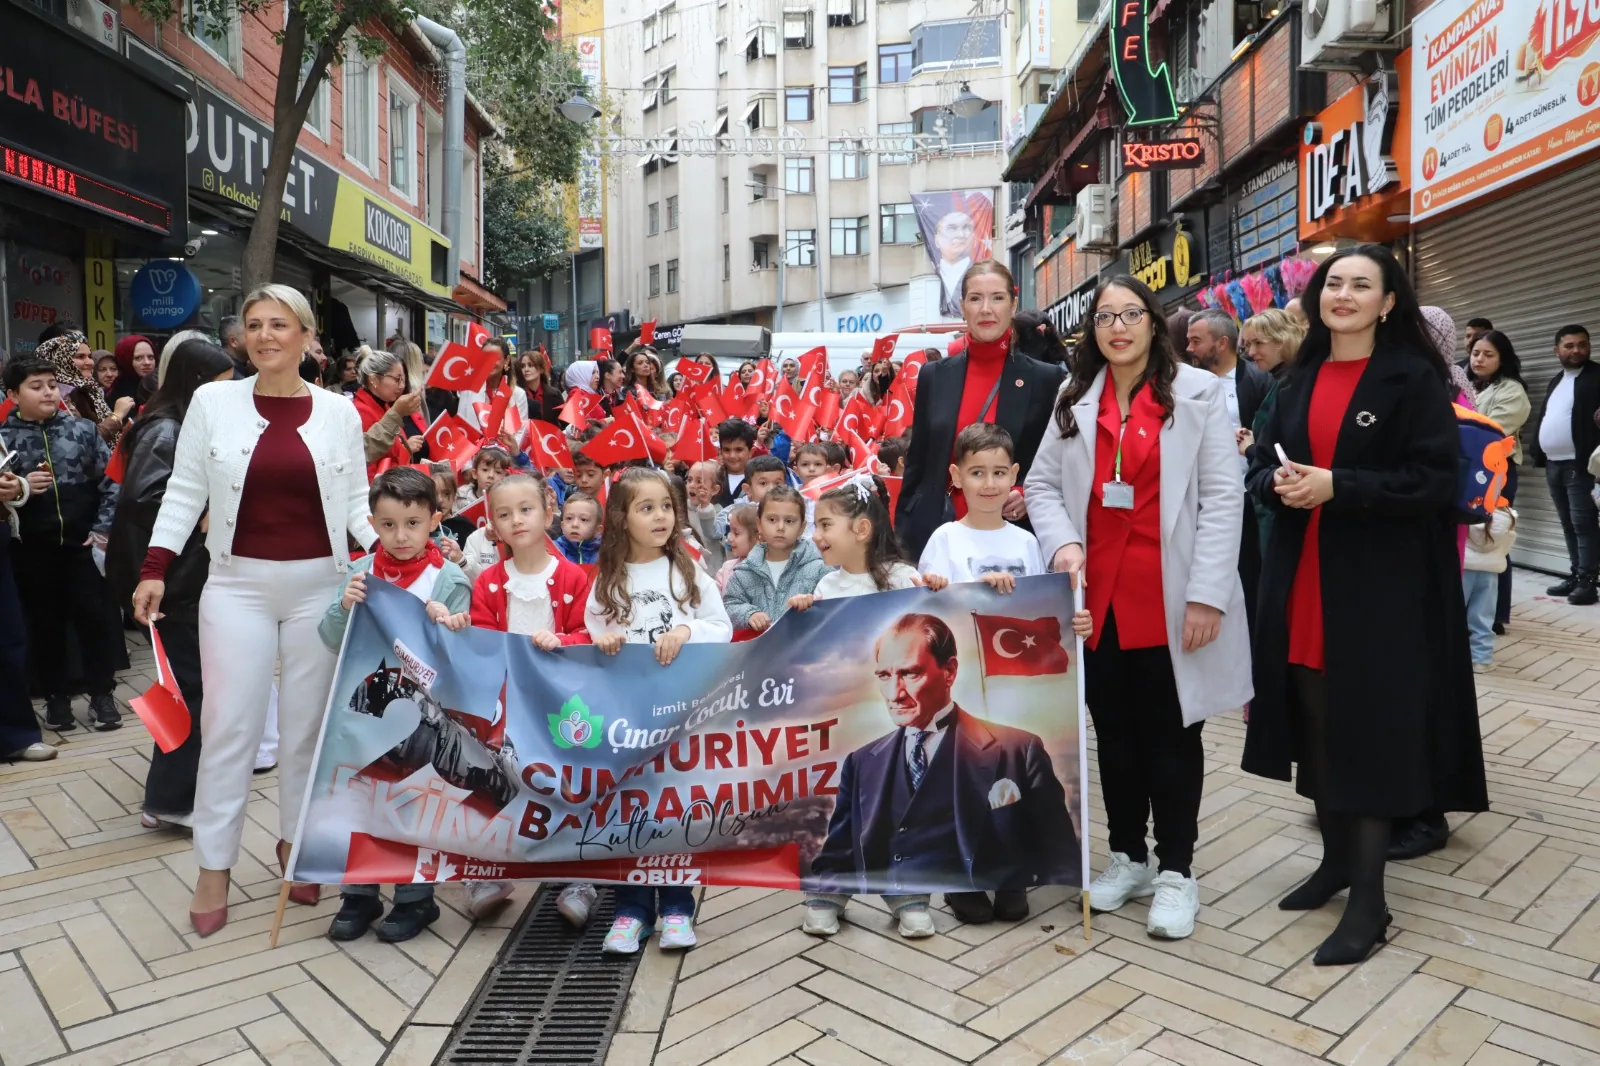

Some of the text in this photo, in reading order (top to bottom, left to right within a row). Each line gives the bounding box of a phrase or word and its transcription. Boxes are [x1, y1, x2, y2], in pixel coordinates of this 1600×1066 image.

[103, 31, 113, 43] LG
[1429, 0, 1501, 63] KAMPANYA
[1430, 24, 1498, 105] EVİNİZİN
[1424, 103, 1446, 134] TÜM
[1447, 49, 1509, 119] PERDELERİ
[0, 65, 138, 153] LA BÜFESİ
[1505, 93, 1567, 135] 4 ADET GÜNEŞLİK
[1123, 142, 1200, 169] KRISTO
[1439, 142, 1471, 167] 4 ADET TÜL
[367, 204, 410, 259] KOKOSH
[13, 299, 57, 325] SÜPER
[142, 306, 185, 317] piyango
[152, 296, 174, 306] milli
[1048, 290, 1080, 333] OTTON
[672, 325, 685, 338] GÖ
[837, 312, 883, 333] FOKO
[652, 671, 745, 717] İzmit Beyesi
[607, 718, 681, 754] Çınar
[758, 677, 795, 707] Evi
[517, 760, 840, 842] BAYRAMIMIZ
[575, 798, 791, 861] Kutlu Olsun
[463, 862, 506, 877] İZMİT
[626, 868, 703, 886] OBUZ
[636, 853, 693, 869] Lütfü
